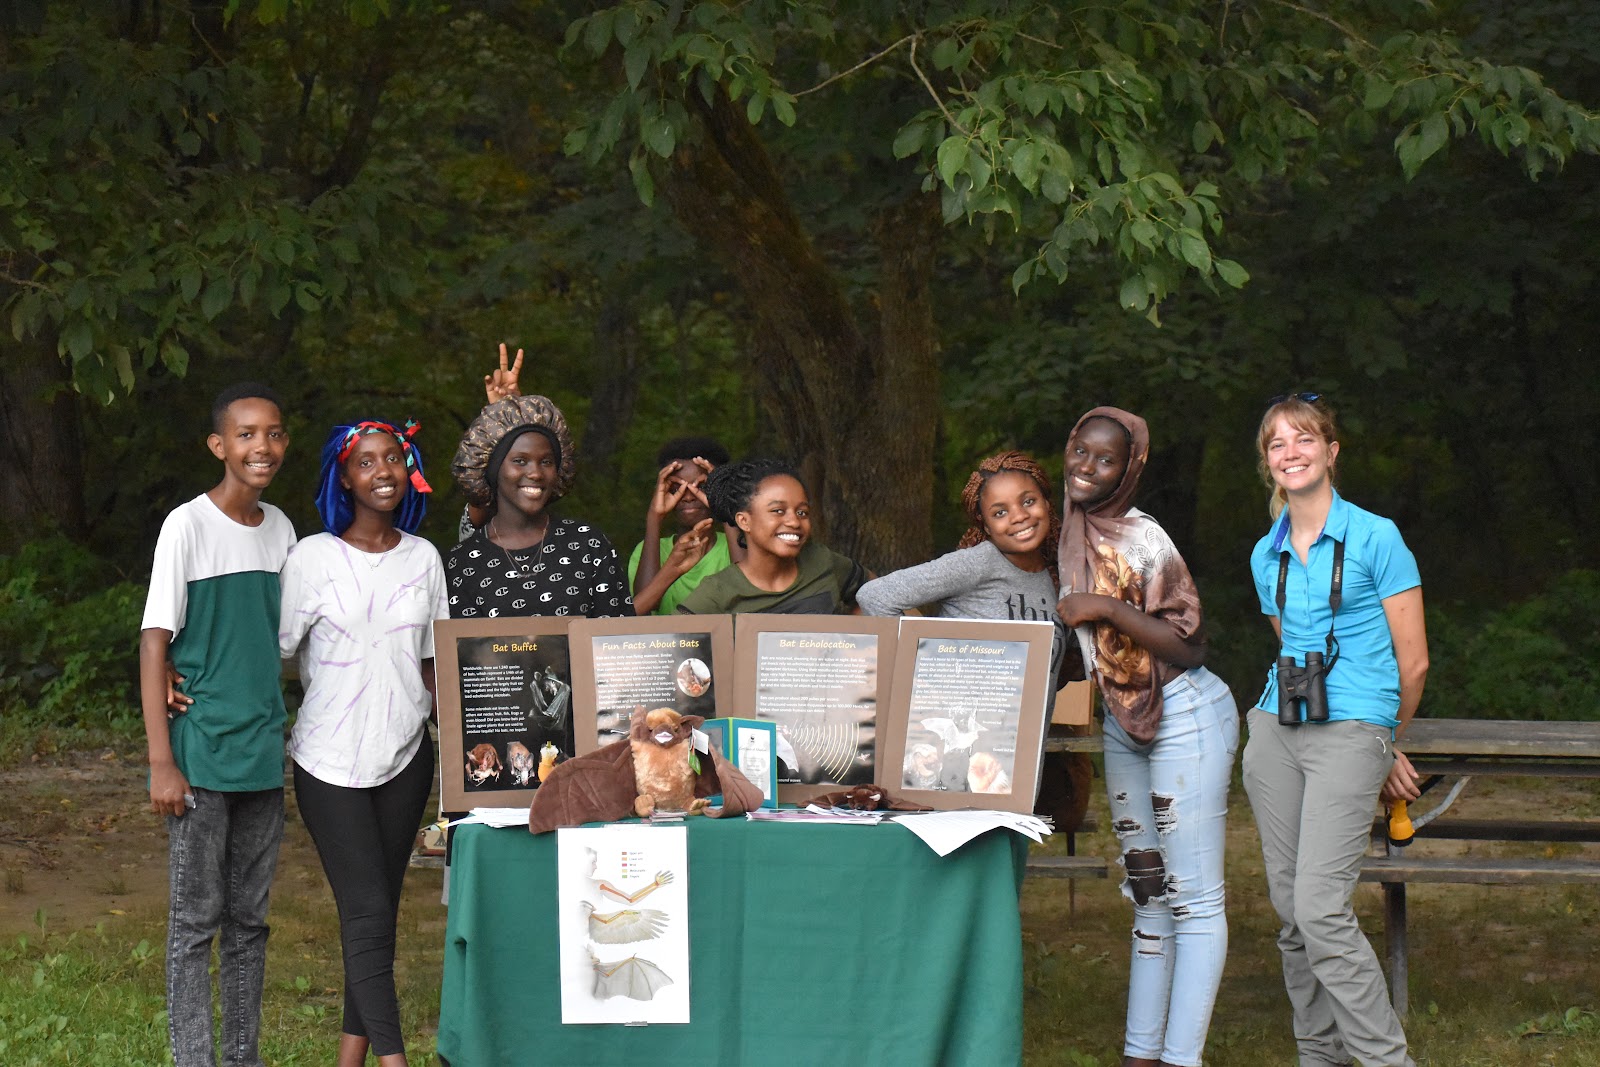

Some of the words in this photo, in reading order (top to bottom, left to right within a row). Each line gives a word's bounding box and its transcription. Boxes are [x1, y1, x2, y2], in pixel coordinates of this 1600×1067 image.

[492, 644, 508, 652] Bat
[511, 642, 538, 651] Buffet
[603, 643, 619, 651] Fun
[623, 641, 646, 650] Facts
[649, 640, 676, 649] About
[680, 640, 700, 648] Bats
[800, 640, 856, 649] Echolocation
[938, 645, 956, 653] Bats
[960, 645, 968, 654] of
[970, 646, 1005, 654] Missouri
